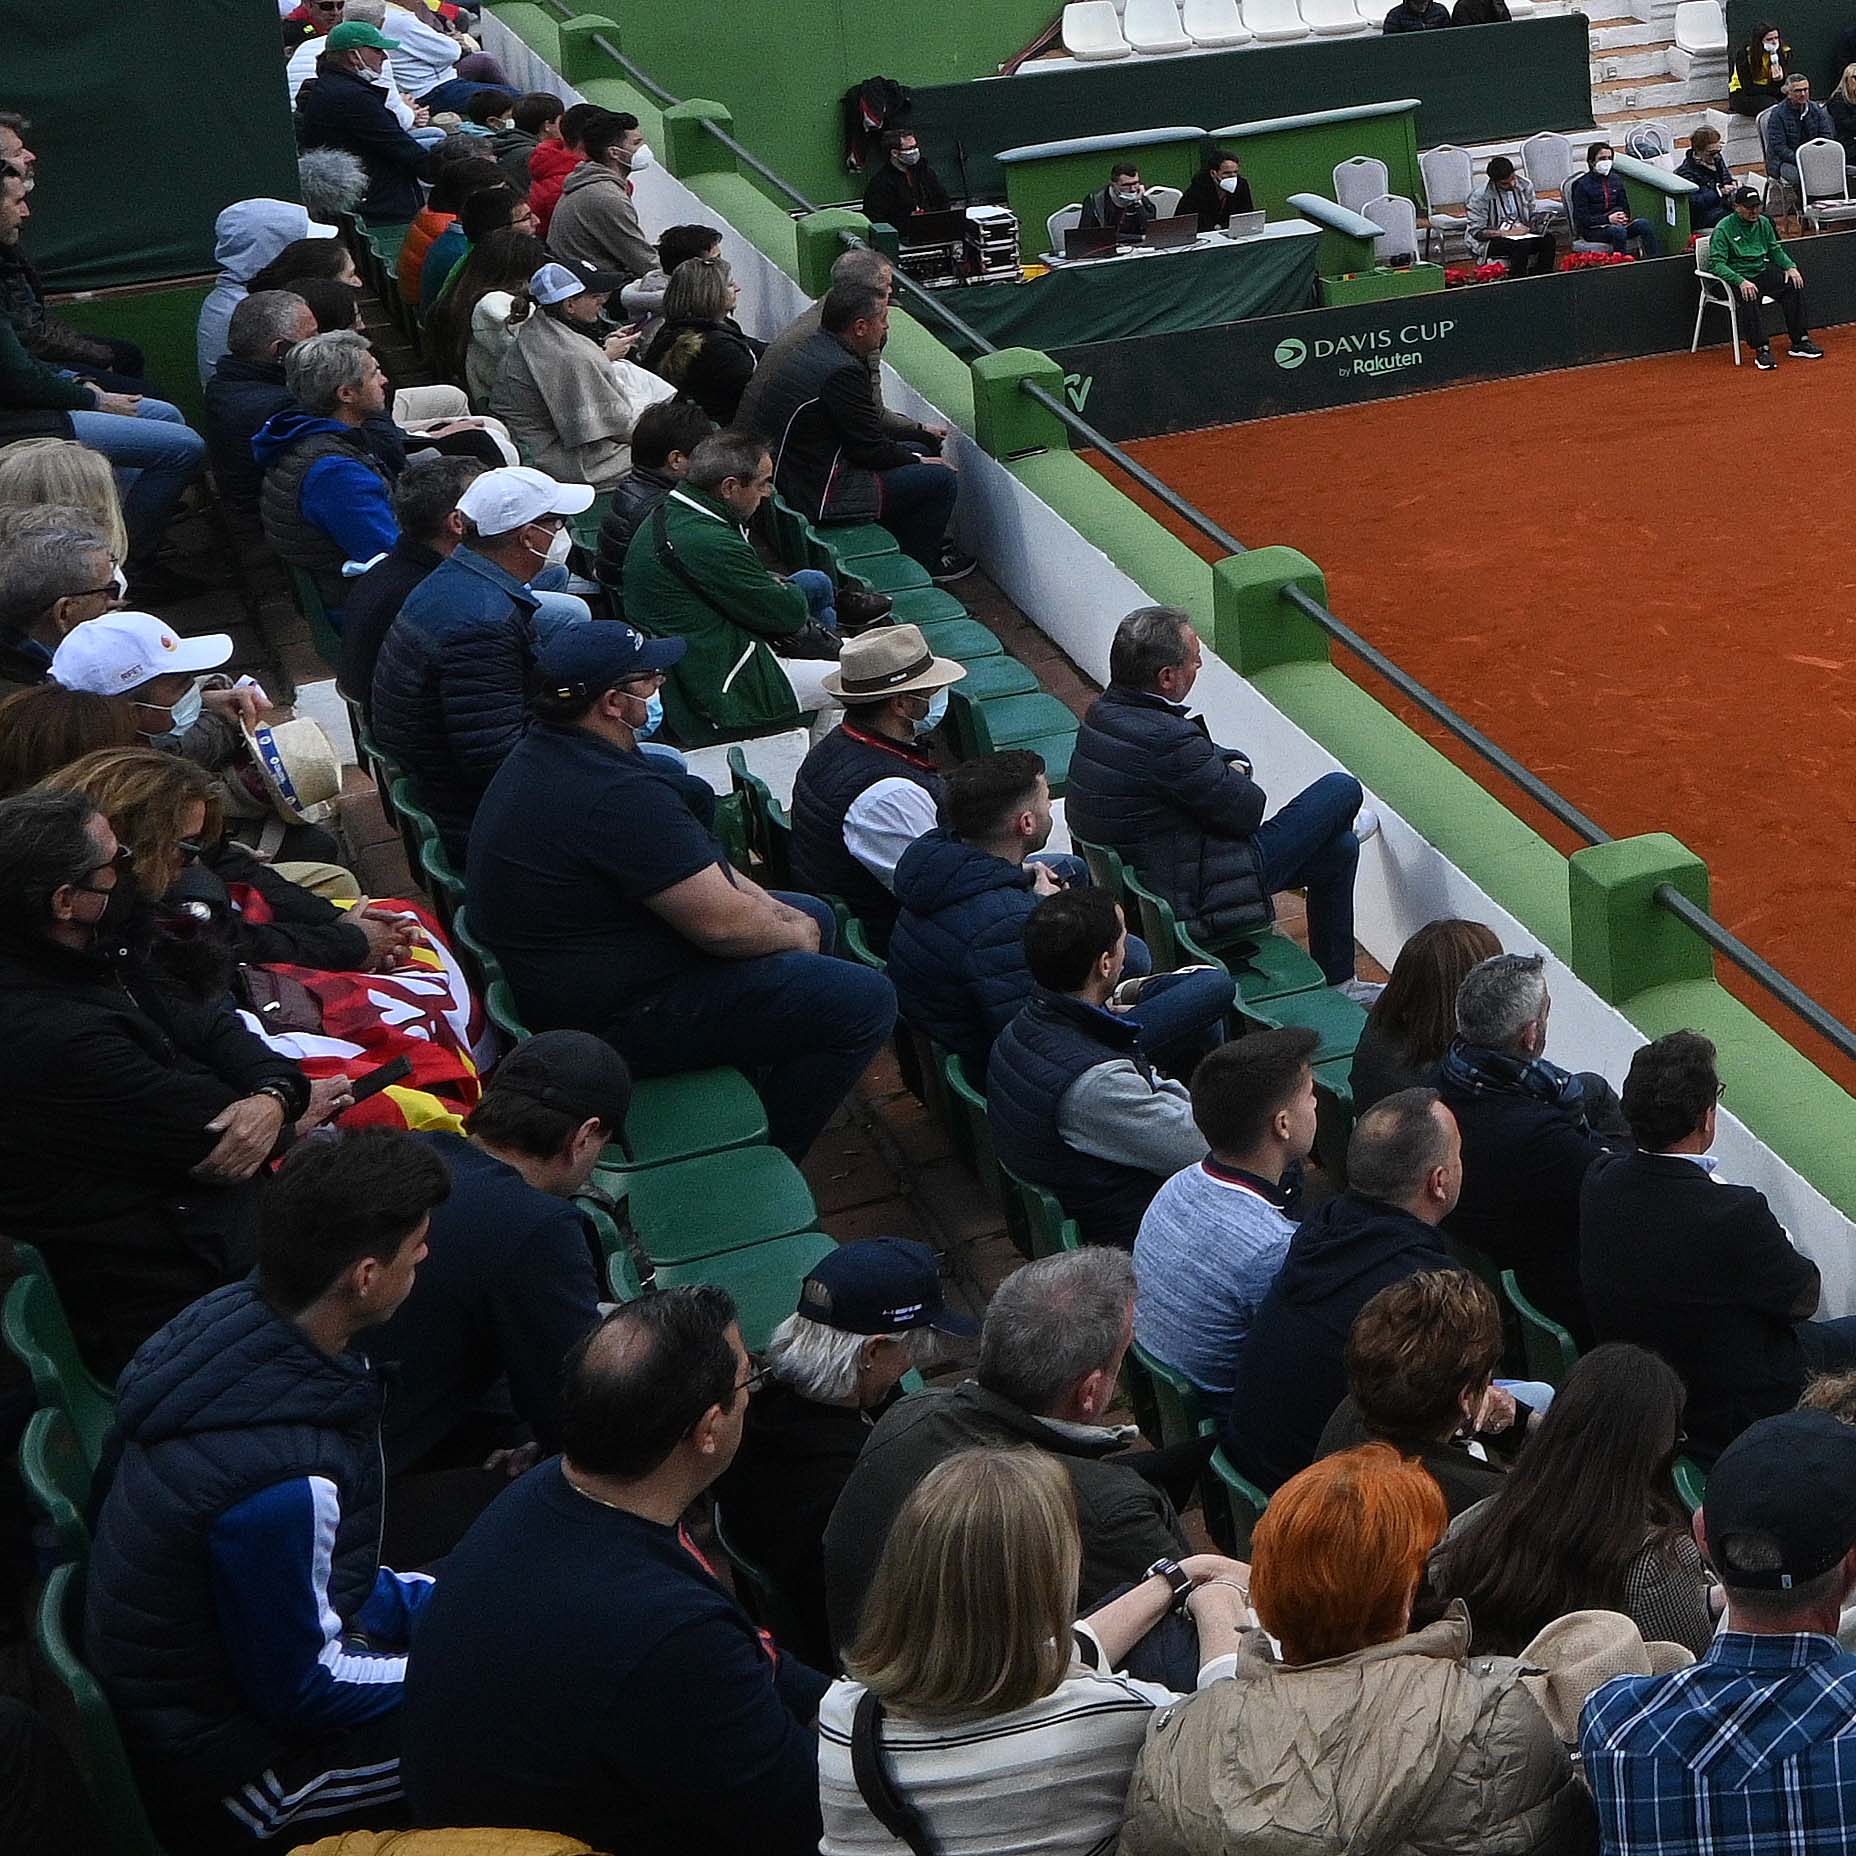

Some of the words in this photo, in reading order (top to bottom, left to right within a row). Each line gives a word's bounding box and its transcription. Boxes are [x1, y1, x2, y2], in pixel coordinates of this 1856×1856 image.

[1314, 331, 1391, 358] DAVIS
[1400, 320, 1456, 343] CUP
[1338, 367, 1351, 377] by
[1353, 350, 1423, 375] Rakuten
